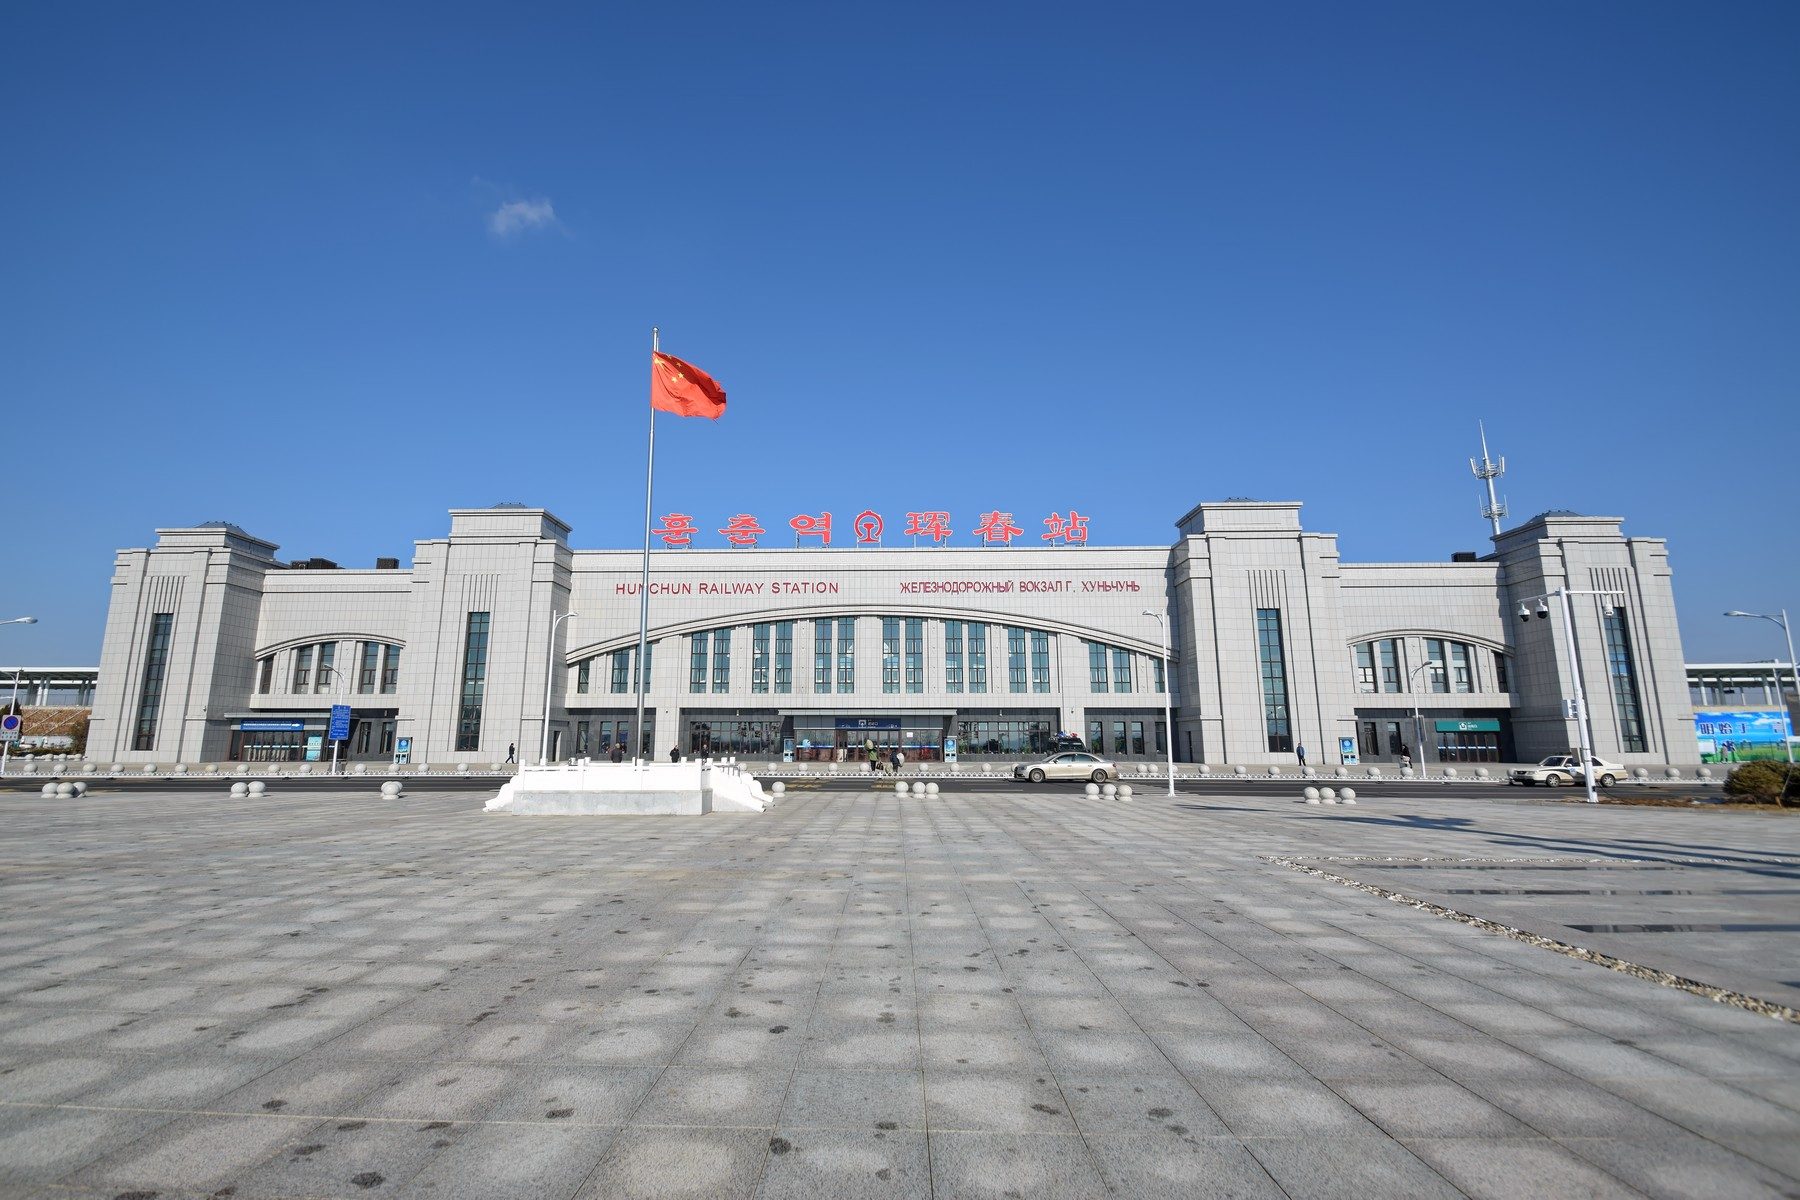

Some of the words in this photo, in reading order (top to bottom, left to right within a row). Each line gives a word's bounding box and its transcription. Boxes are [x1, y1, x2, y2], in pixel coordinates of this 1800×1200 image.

[651, 511, 833, 545] 훈춘역
[904, 510, 1090, 543] 珲春站
[698, 582, 764, 595] RAILWAY
[771, 581, 839, 594] STATION
[900, 579, 1014, 595] ЖЕЛЕЗНОДОРОЖНЫЙ
[1081, 580, 1141, 593] ХУНЬЧУНЬ
